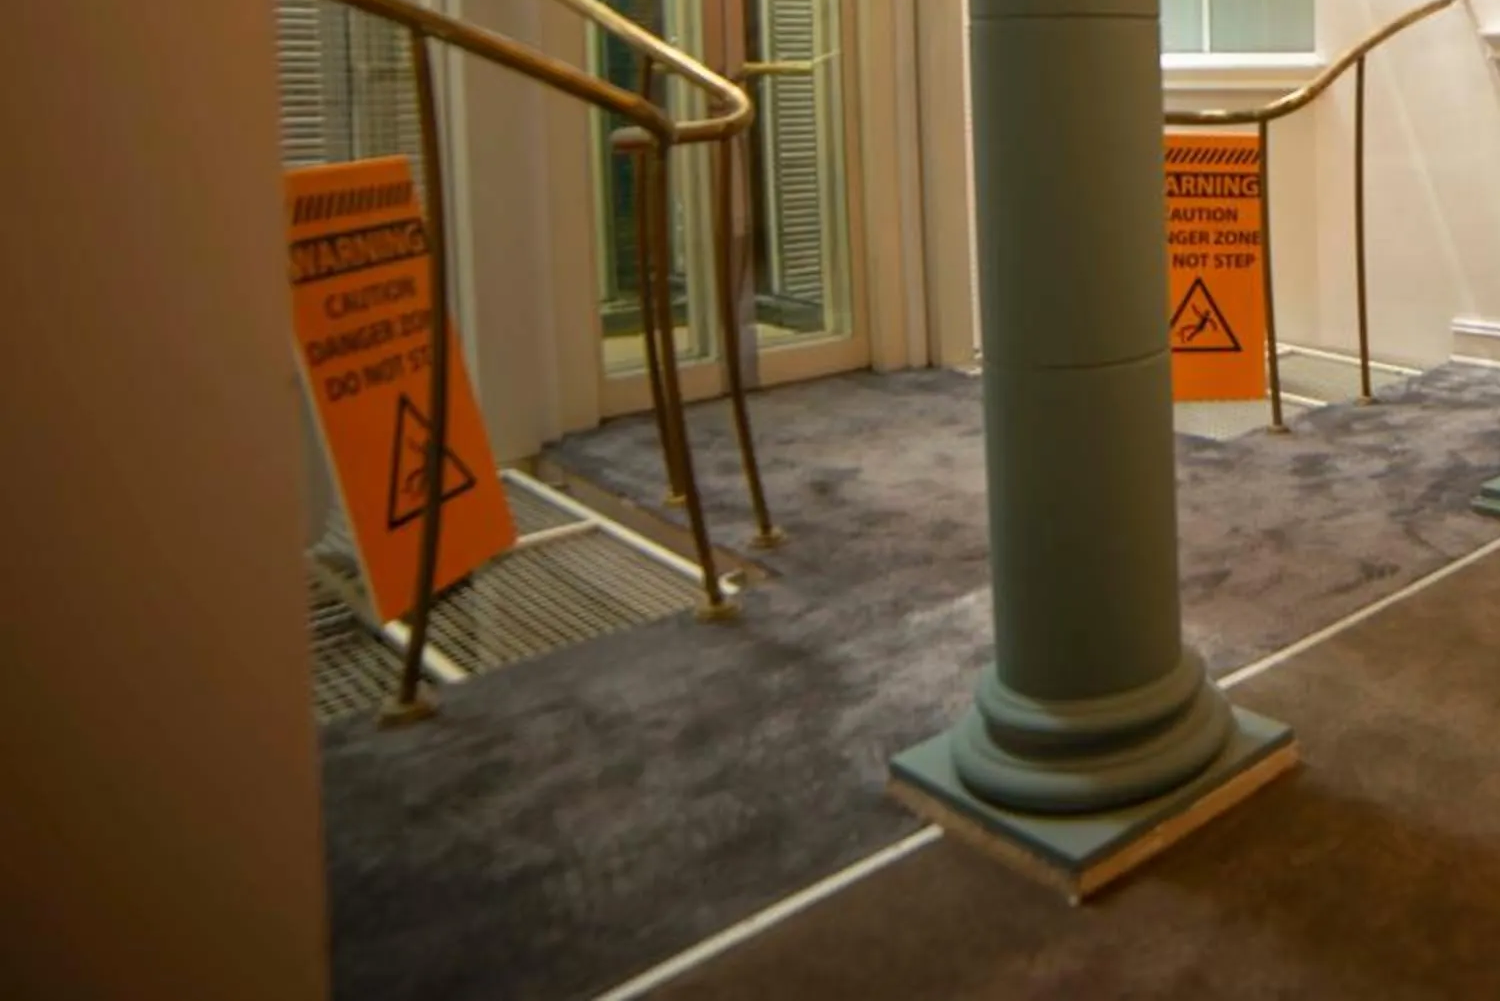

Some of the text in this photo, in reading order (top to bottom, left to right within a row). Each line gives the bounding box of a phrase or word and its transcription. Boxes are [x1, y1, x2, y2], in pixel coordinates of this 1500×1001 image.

[1164, 175, 1259, 195] ARNING
[1170, 207, 1238, 222] AUTION
[291, 225, 425, 280] WARNING
[1213, 230, 1261, 245] ZONE
[1172, 253, 1256, 268] NOT STEP
[325, 276, 415, 318] CAUTION
[306, 319, 394, 367] DANGER
[325, 344, 432, 402] DO NOT ST
